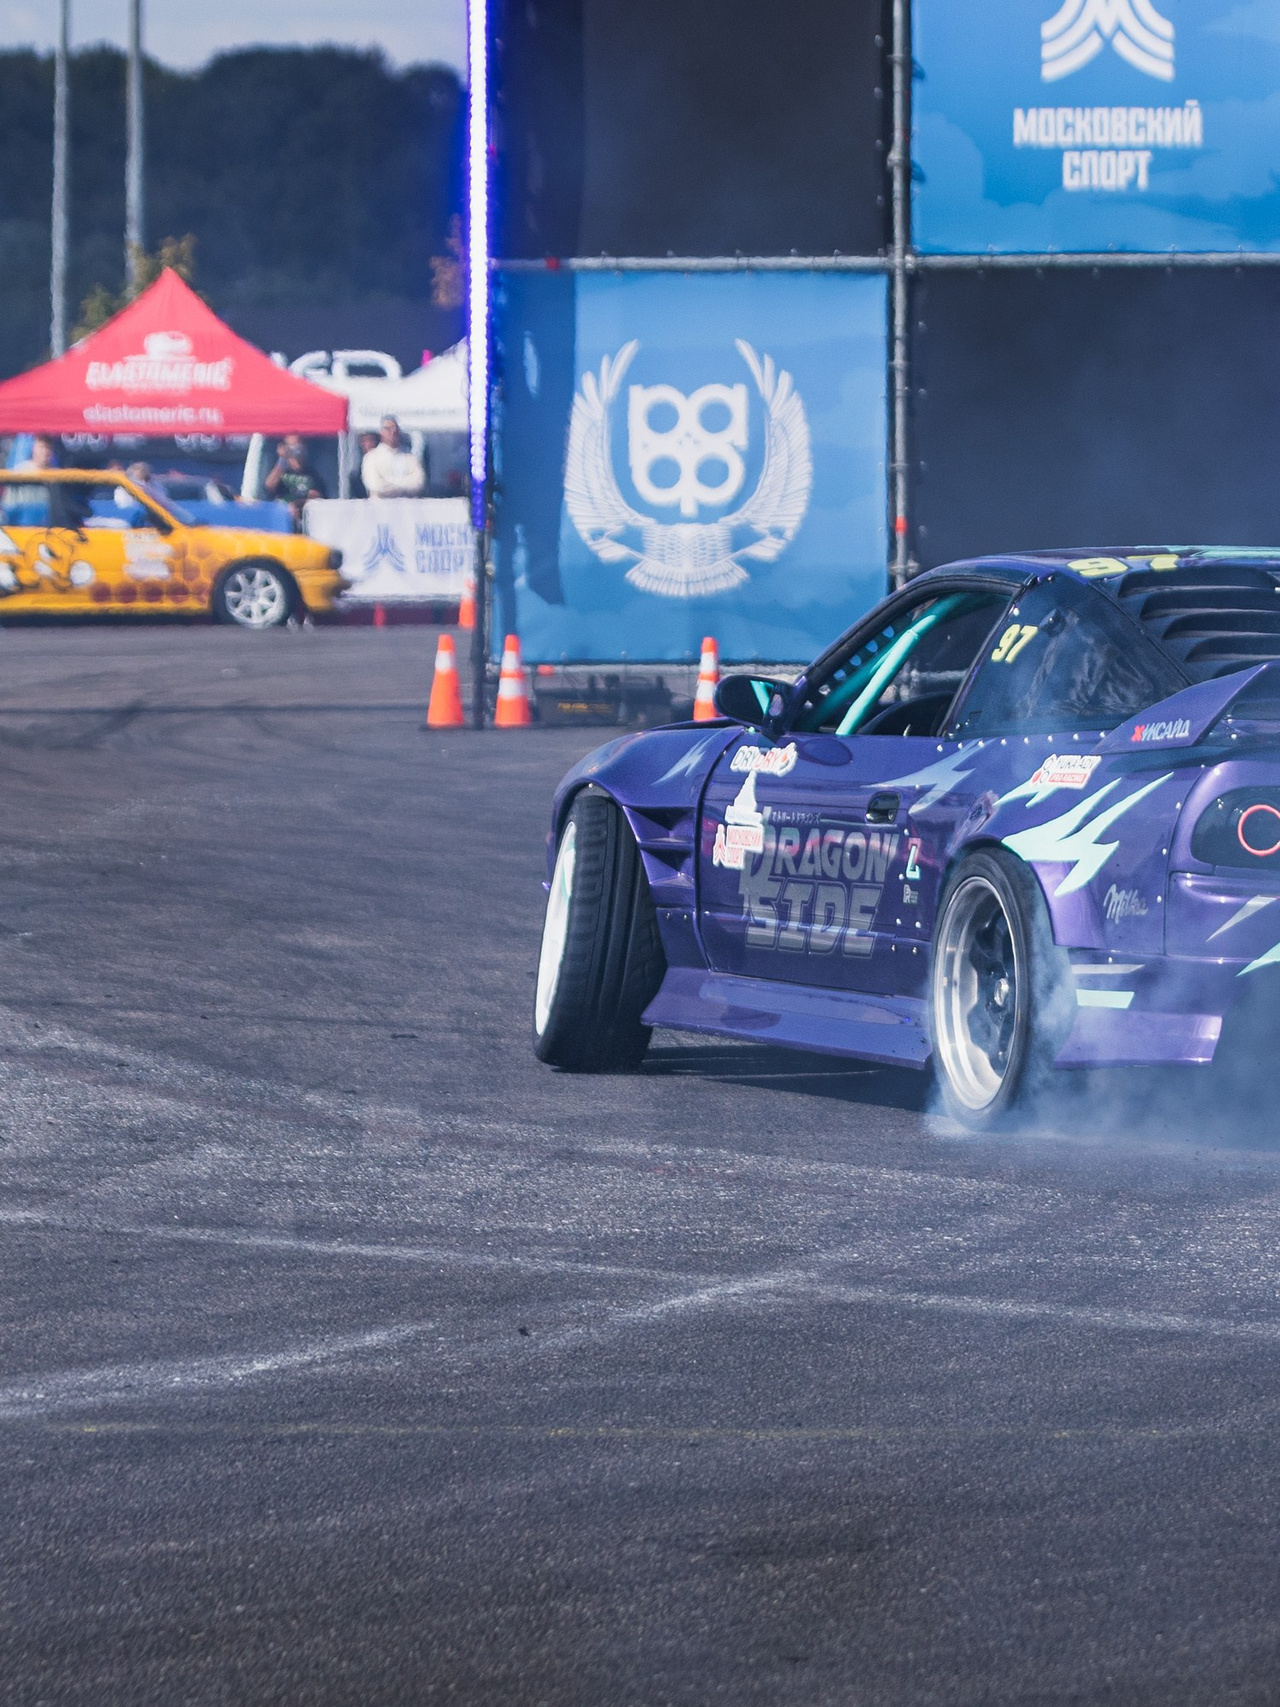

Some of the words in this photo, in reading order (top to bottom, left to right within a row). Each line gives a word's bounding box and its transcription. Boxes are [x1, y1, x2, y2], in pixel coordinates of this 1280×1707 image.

[1012, 100, 1203, 147] МОСКОВСКИЙ
[1062, 151, 1152, 190] СПОРТ
[991, 624, 1038, 663] 97
[744, 877, 884, 959] SIDE
